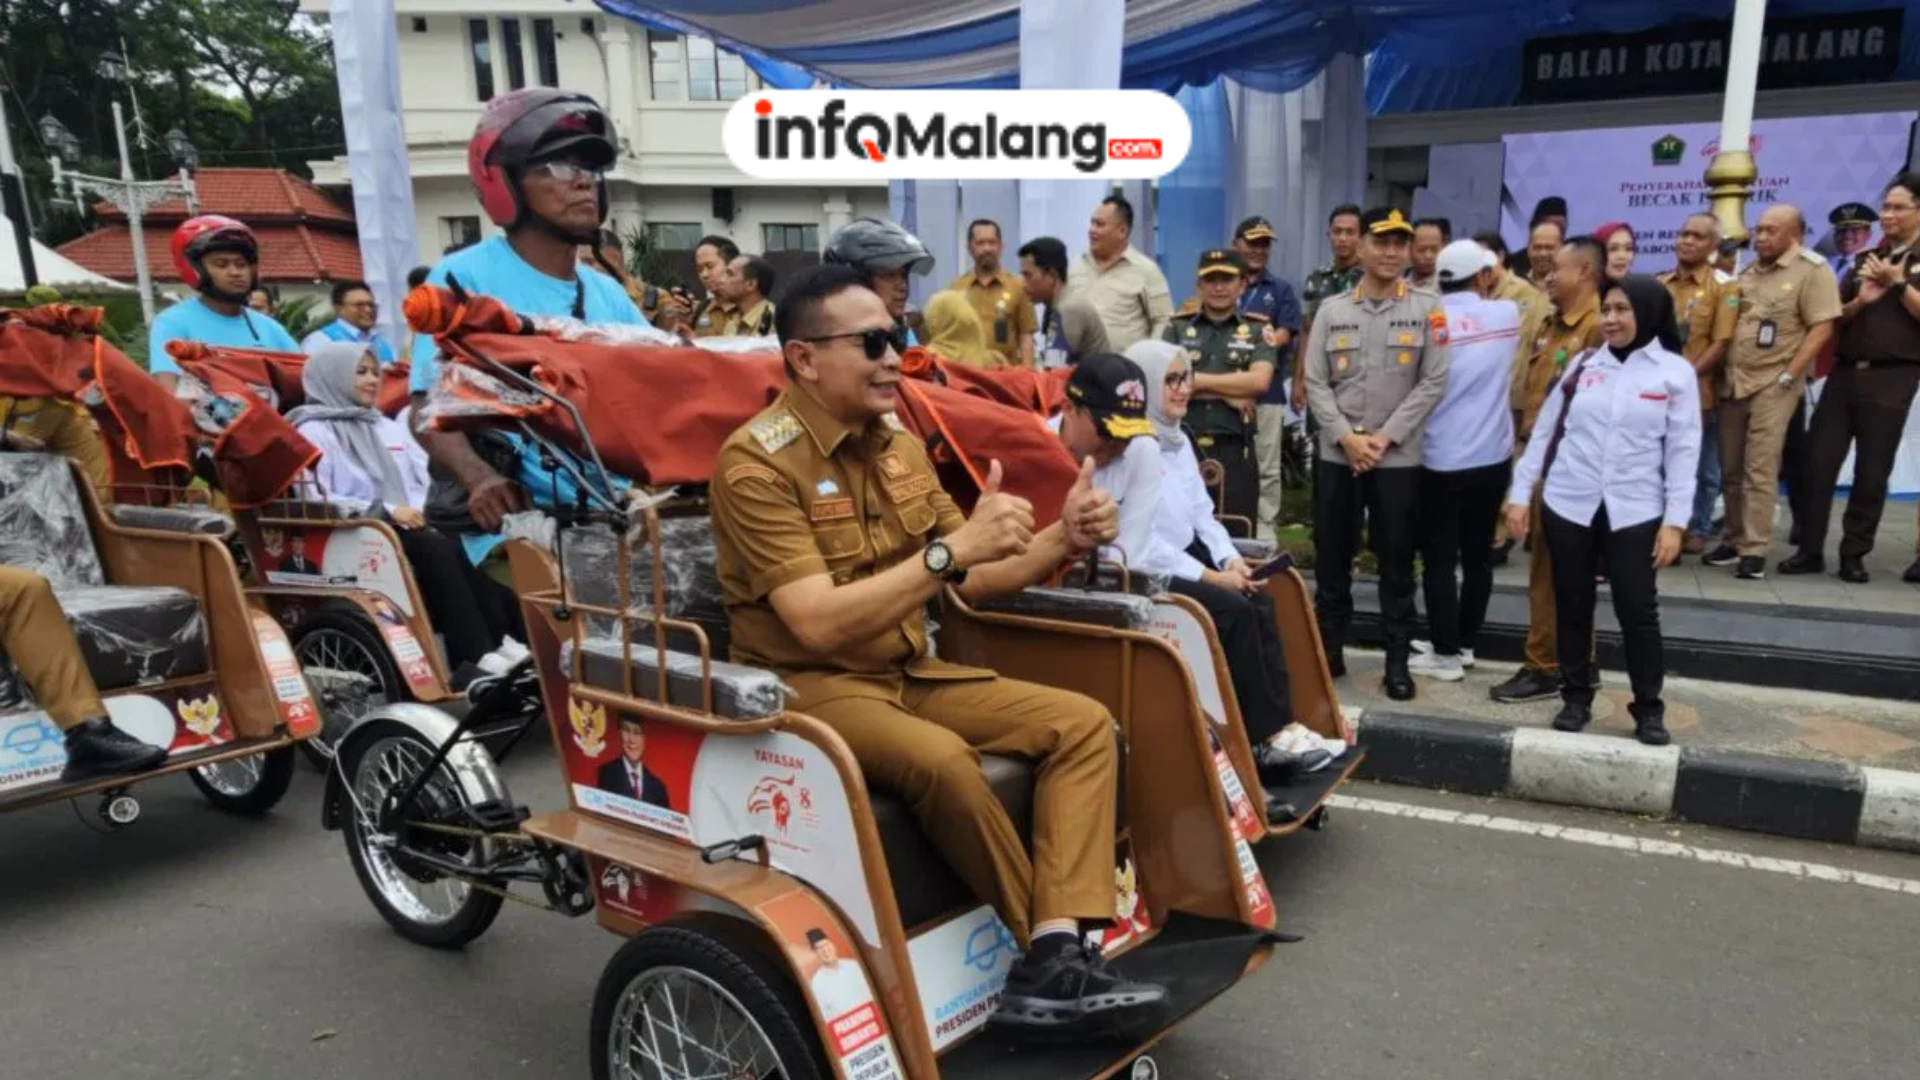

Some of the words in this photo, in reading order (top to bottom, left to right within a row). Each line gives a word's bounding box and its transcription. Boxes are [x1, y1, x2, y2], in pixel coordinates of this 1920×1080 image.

[1536, 46, 1629, 79] BALAI
[1643, 38, 1722, 73] KOTA
[1620, 180, 1706, 193] PENYERAHA
[1628, 193, 1692, 208] BECAK
[754, 747, 805, 770] YAYASAN
[935, 999, 987, 1039] PRESIDEN
